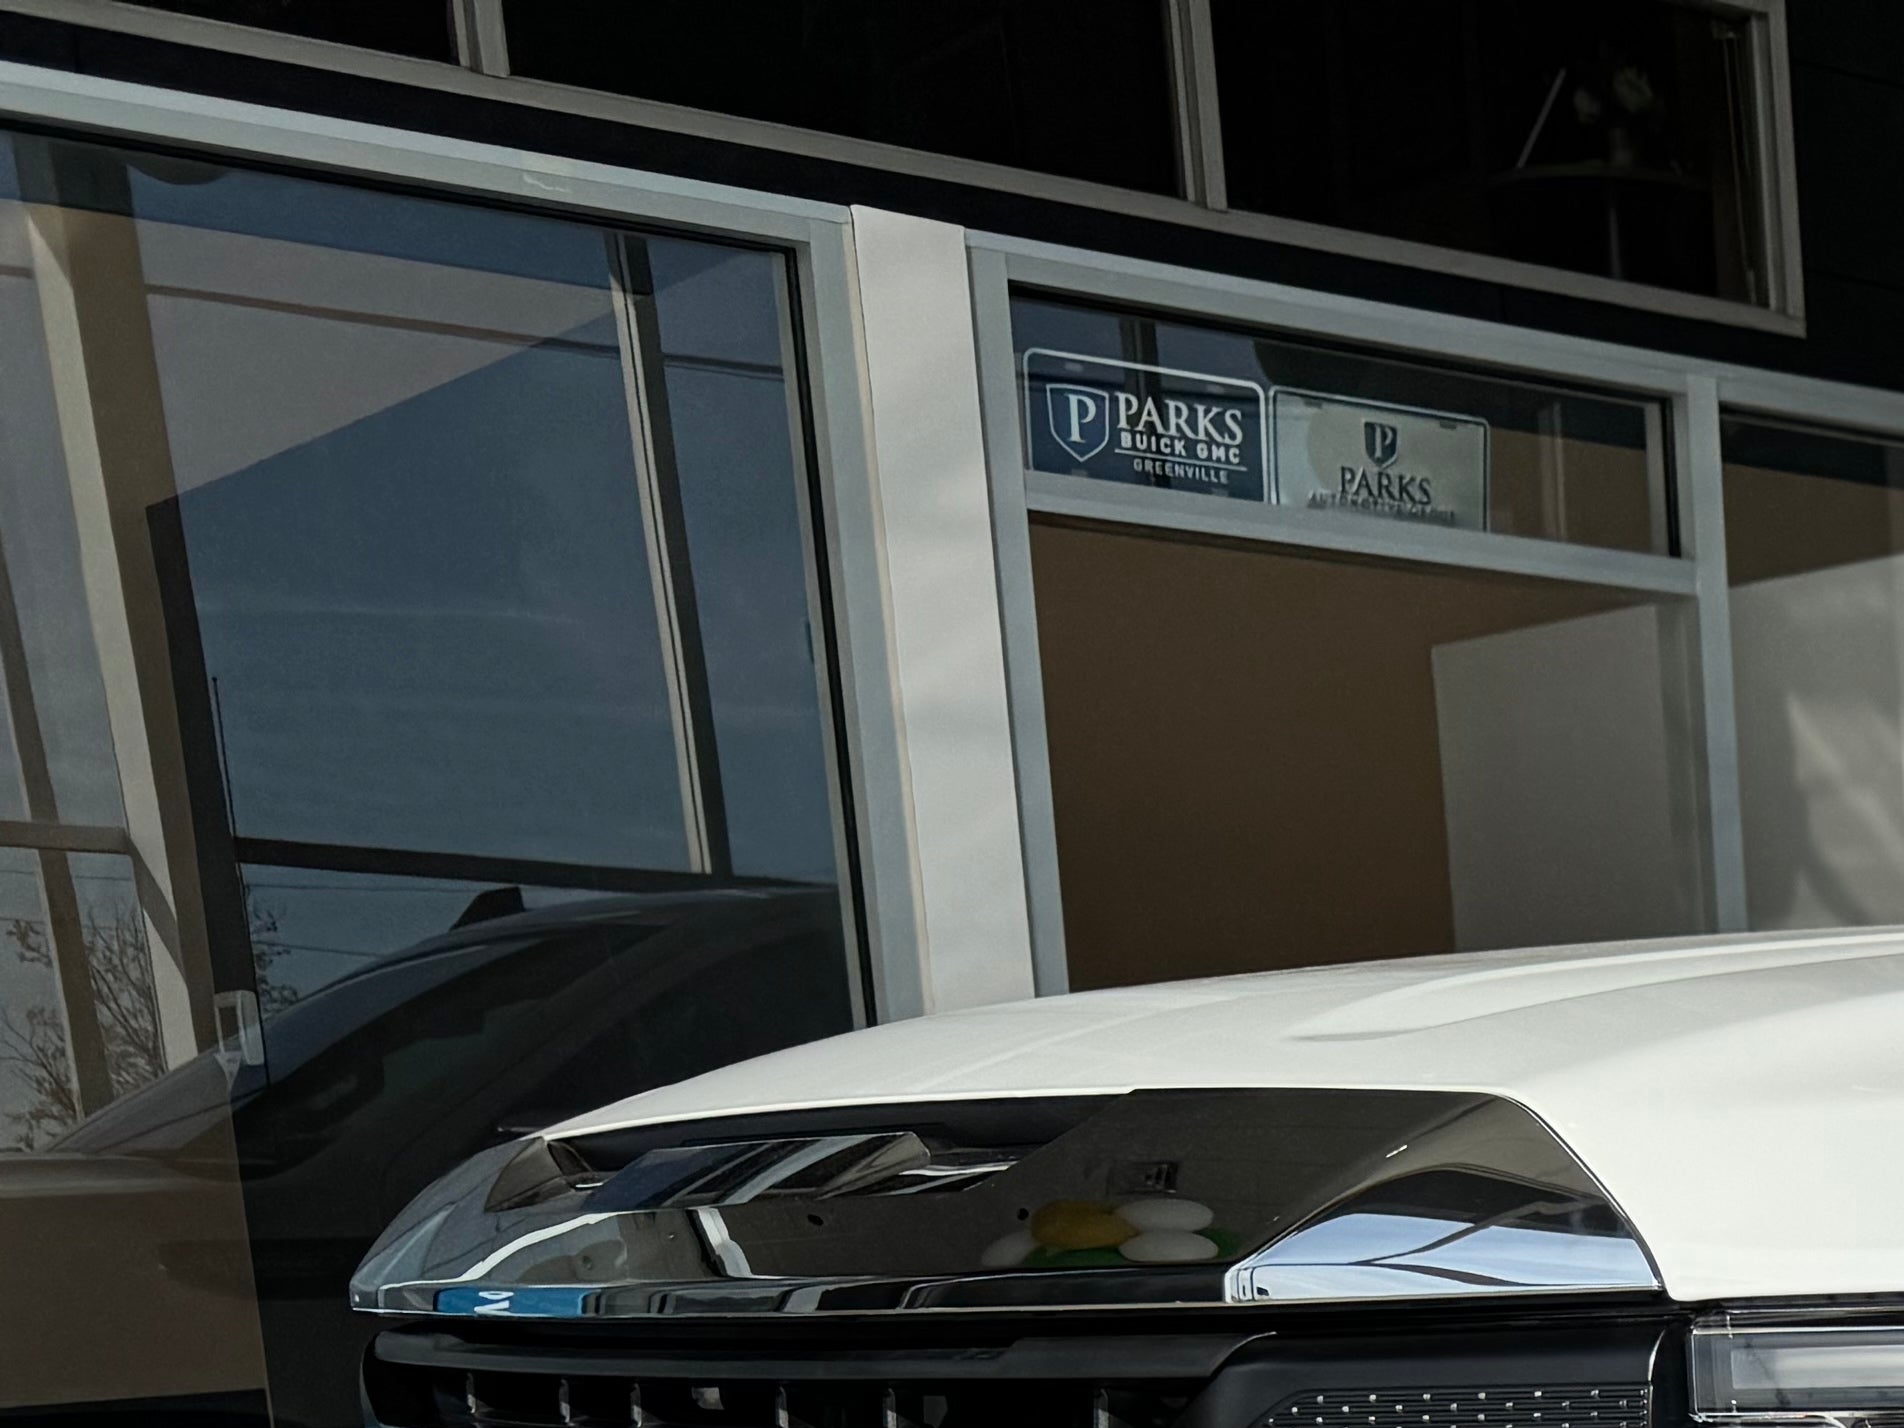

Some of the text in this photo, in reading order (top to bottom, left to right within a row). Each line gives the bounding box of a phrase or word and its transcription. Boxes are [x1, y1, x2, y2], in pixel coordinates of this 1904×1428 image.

[1114, 391, 1245, 446] PARKS
[1119, 430, 1242, 465] BUICK GMC
[1132, 457, 1230, 485] GREENVILLE
[1339, 465, 1432, 506] PARKS
